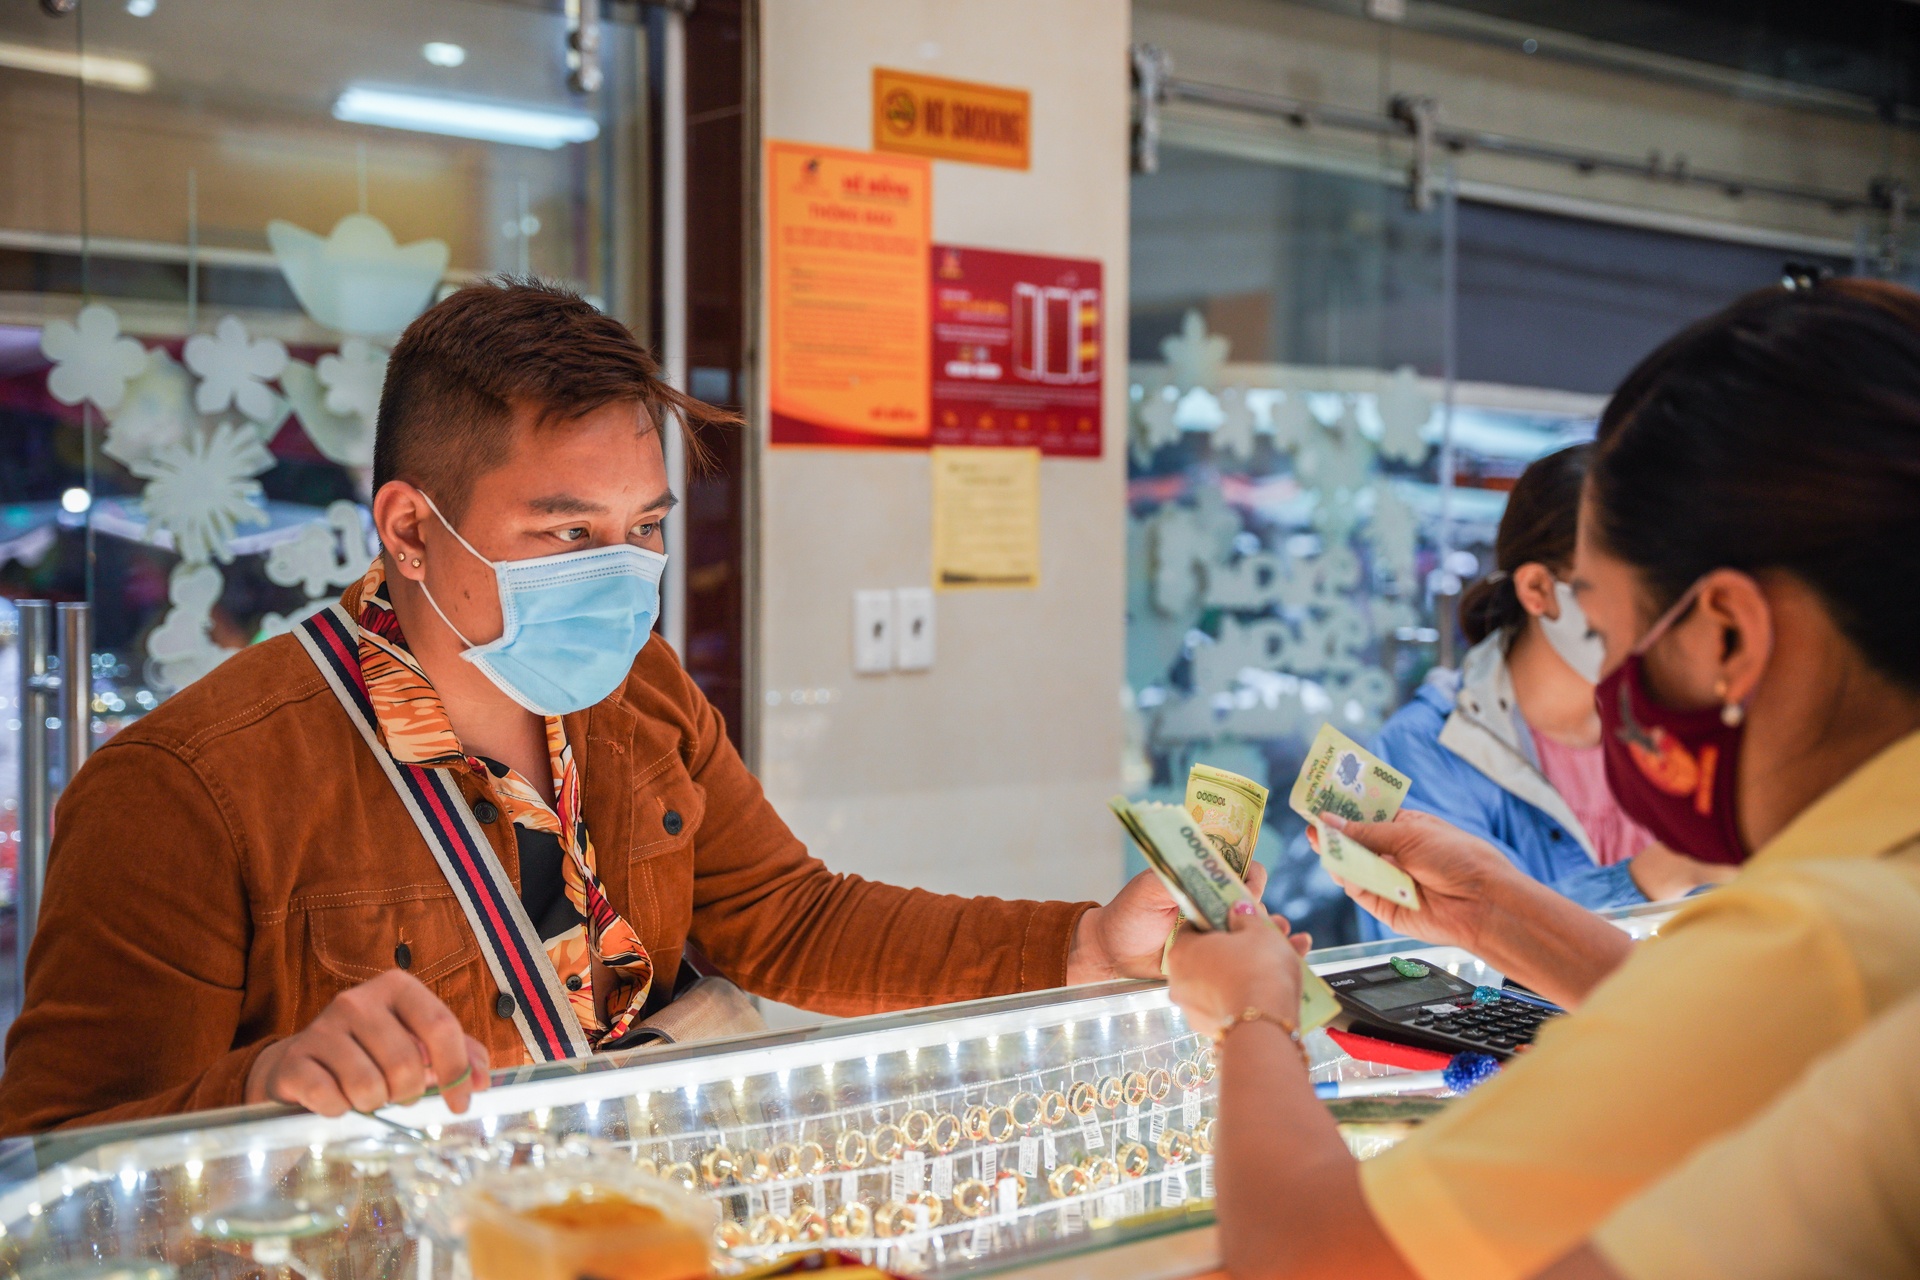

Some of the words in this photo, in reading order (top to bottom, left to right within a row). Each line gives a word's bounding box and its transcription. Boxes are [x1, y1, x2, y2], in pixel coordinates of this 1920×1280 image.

[924, 98, 943, 136] NO
[951, 102, 1023, 147] SMOKING
[1373, 766, 1403, 790] 100000
[1196, 790, 1226, 807] 100000
[1331, 978, 1356, 987] CASIO
